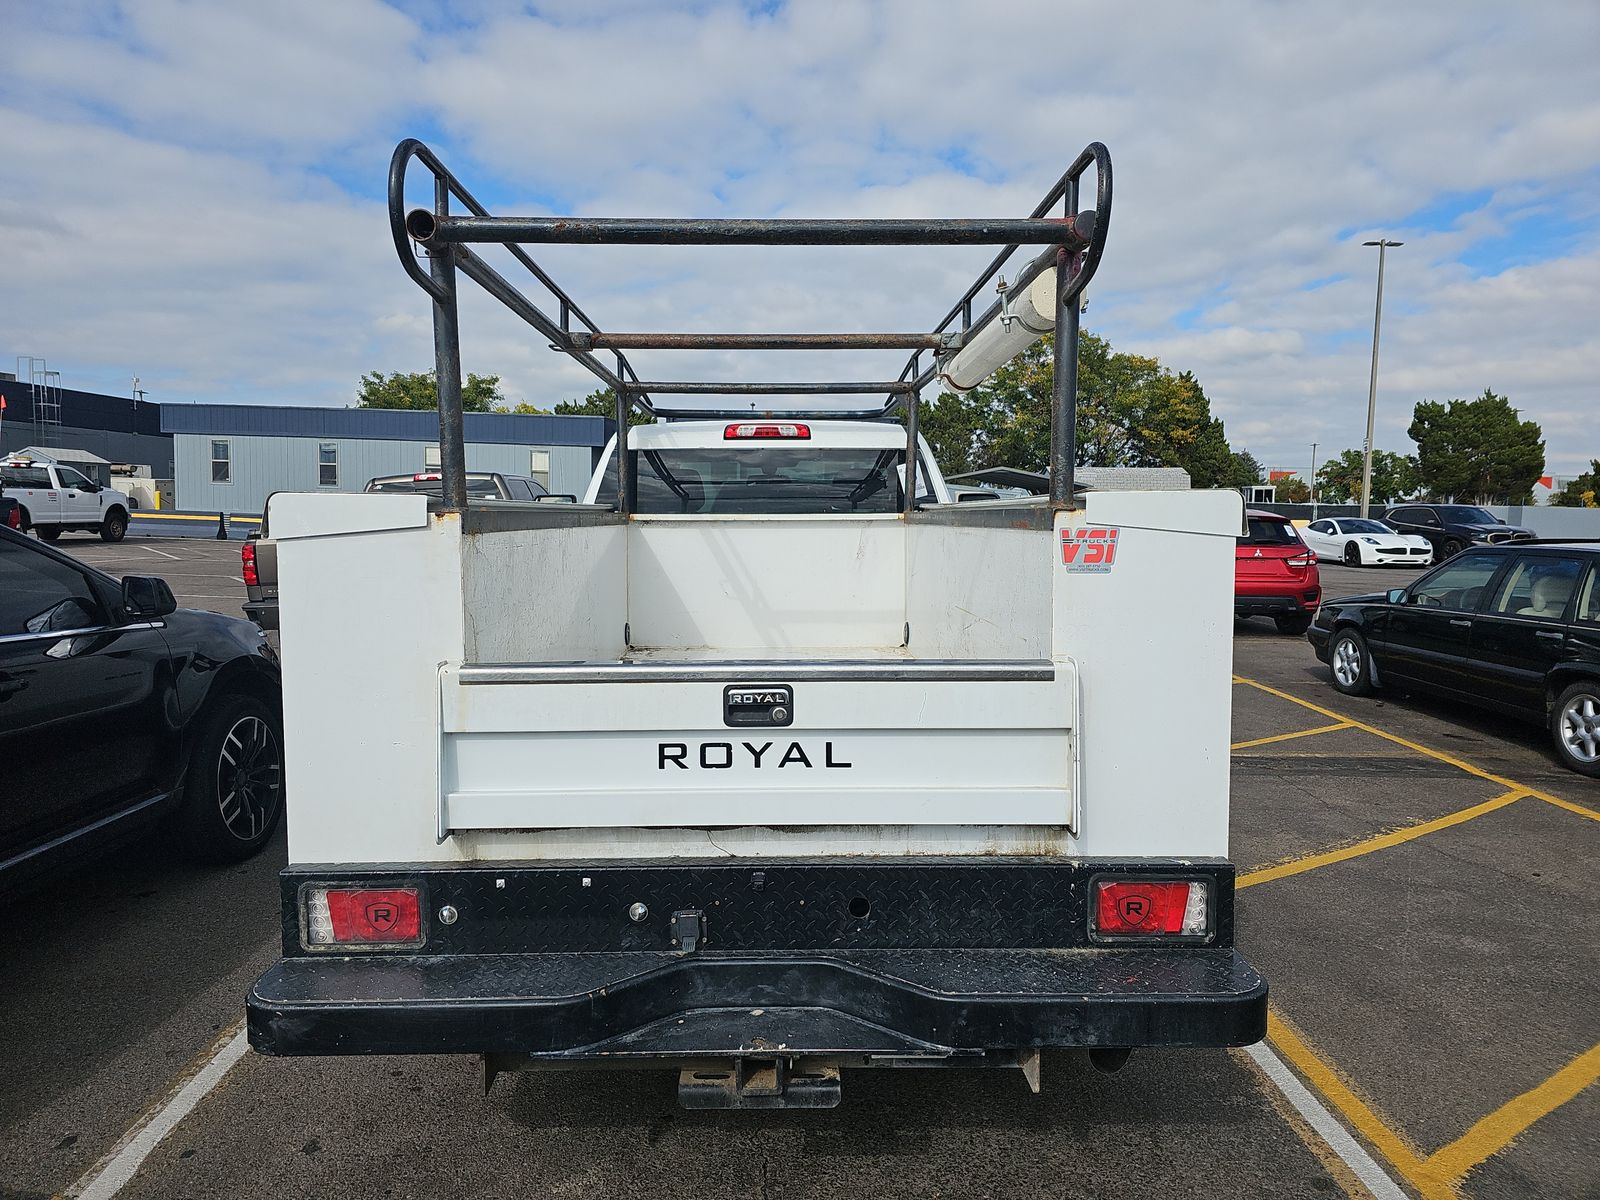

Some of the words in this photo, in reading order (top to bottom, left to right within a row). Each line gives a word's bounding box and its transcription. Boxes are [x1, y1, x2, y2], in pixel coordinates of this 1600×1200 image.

[1062, 530, 1117, 563] VSI
[733, 694, 784, 703] ROYAL
[658, 742, 852, 769] ROYAL
[374, 908, 391, 922] R
[1126, 901, 1143, 916] R
